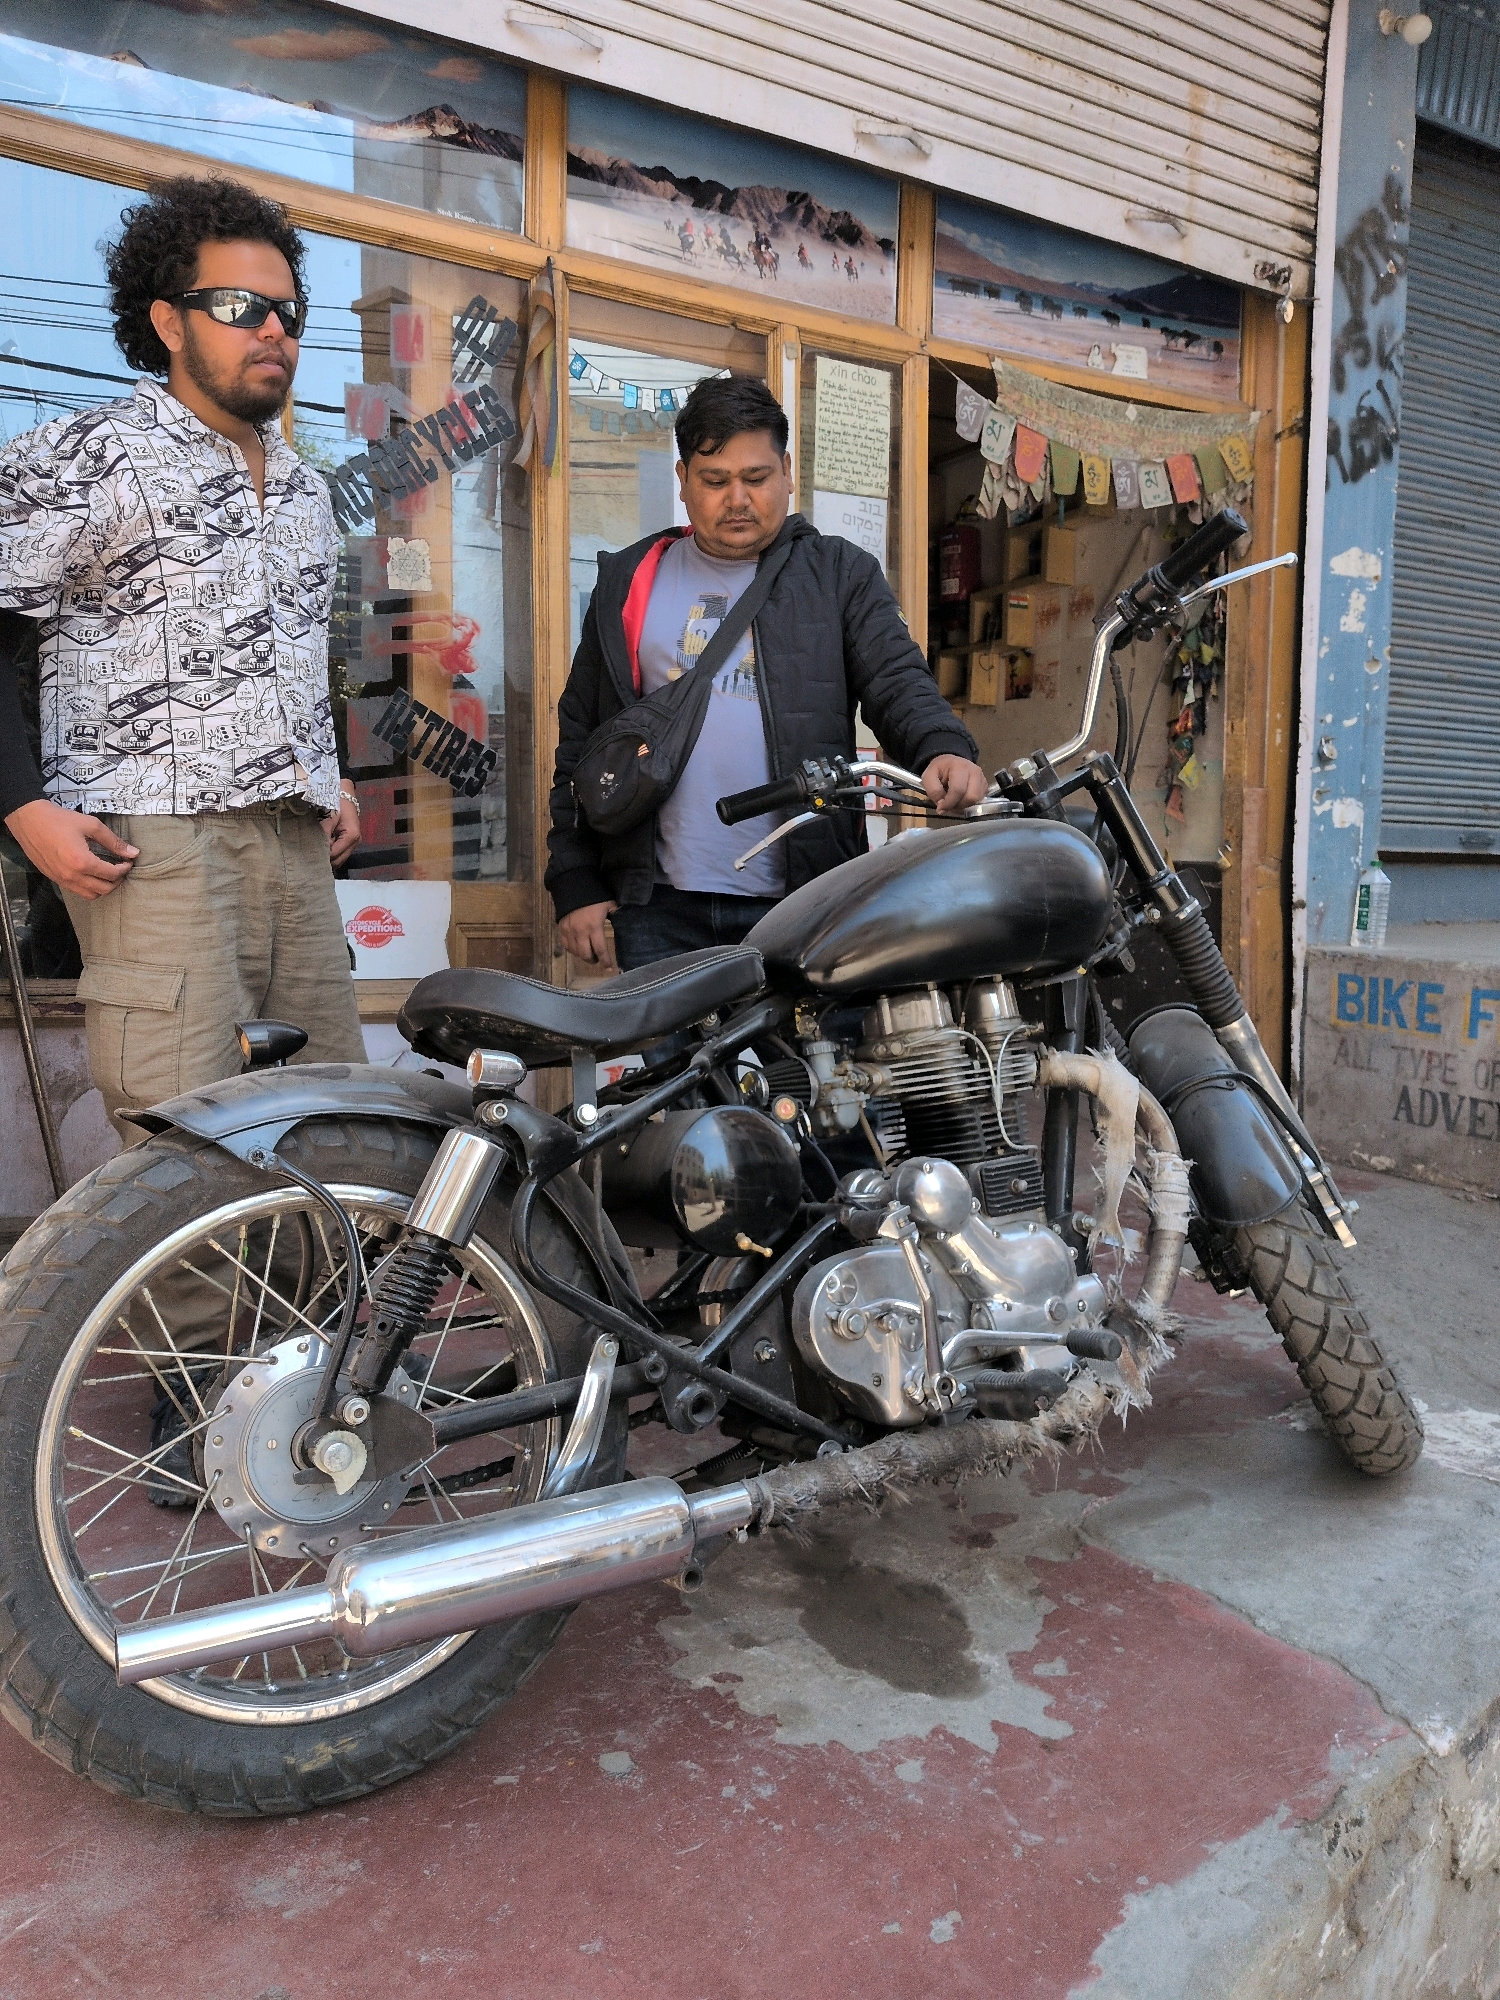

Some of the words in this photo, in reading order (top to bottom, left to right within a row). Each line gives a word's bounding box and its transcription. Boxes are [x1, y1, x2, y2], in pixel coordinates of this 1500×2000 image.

[454, 294, 518, 368] OLD
[830, 365, 848, 379] xin
[851, 368, 877, 386] chào
[133, 446, 148, 454] 12
[325, 383, 516, 534] MOTORCYCLES
[76, 463, 98, 480] MOUNT
[95, 460, 109, 473] FUJI
[32, 490, 54, 503] MOUNT
[53, 494, 68, 504] FUJI
[184, 548, 201, 558] GO
[64, 663, 74, 671] 12
[235, 662, 255, 670] MOUNT
[281, 656, 290, 665] 12
[194, 693, 211, 702] GO
[181, 731, 195, 739] 12
[371, 687, 497, 798] RETIRES
[346, 925, 402, 933] EXPEDITIONS
[1332, 972, 1445, 1038] BIKE
[1463, 988, 1500, 1043] F
[1333, 1037, 1379, 1073] ALL
[1391, 1045, 1457, 1086] TYPE
[1393, 1084, 1500, 1141] ADVE
